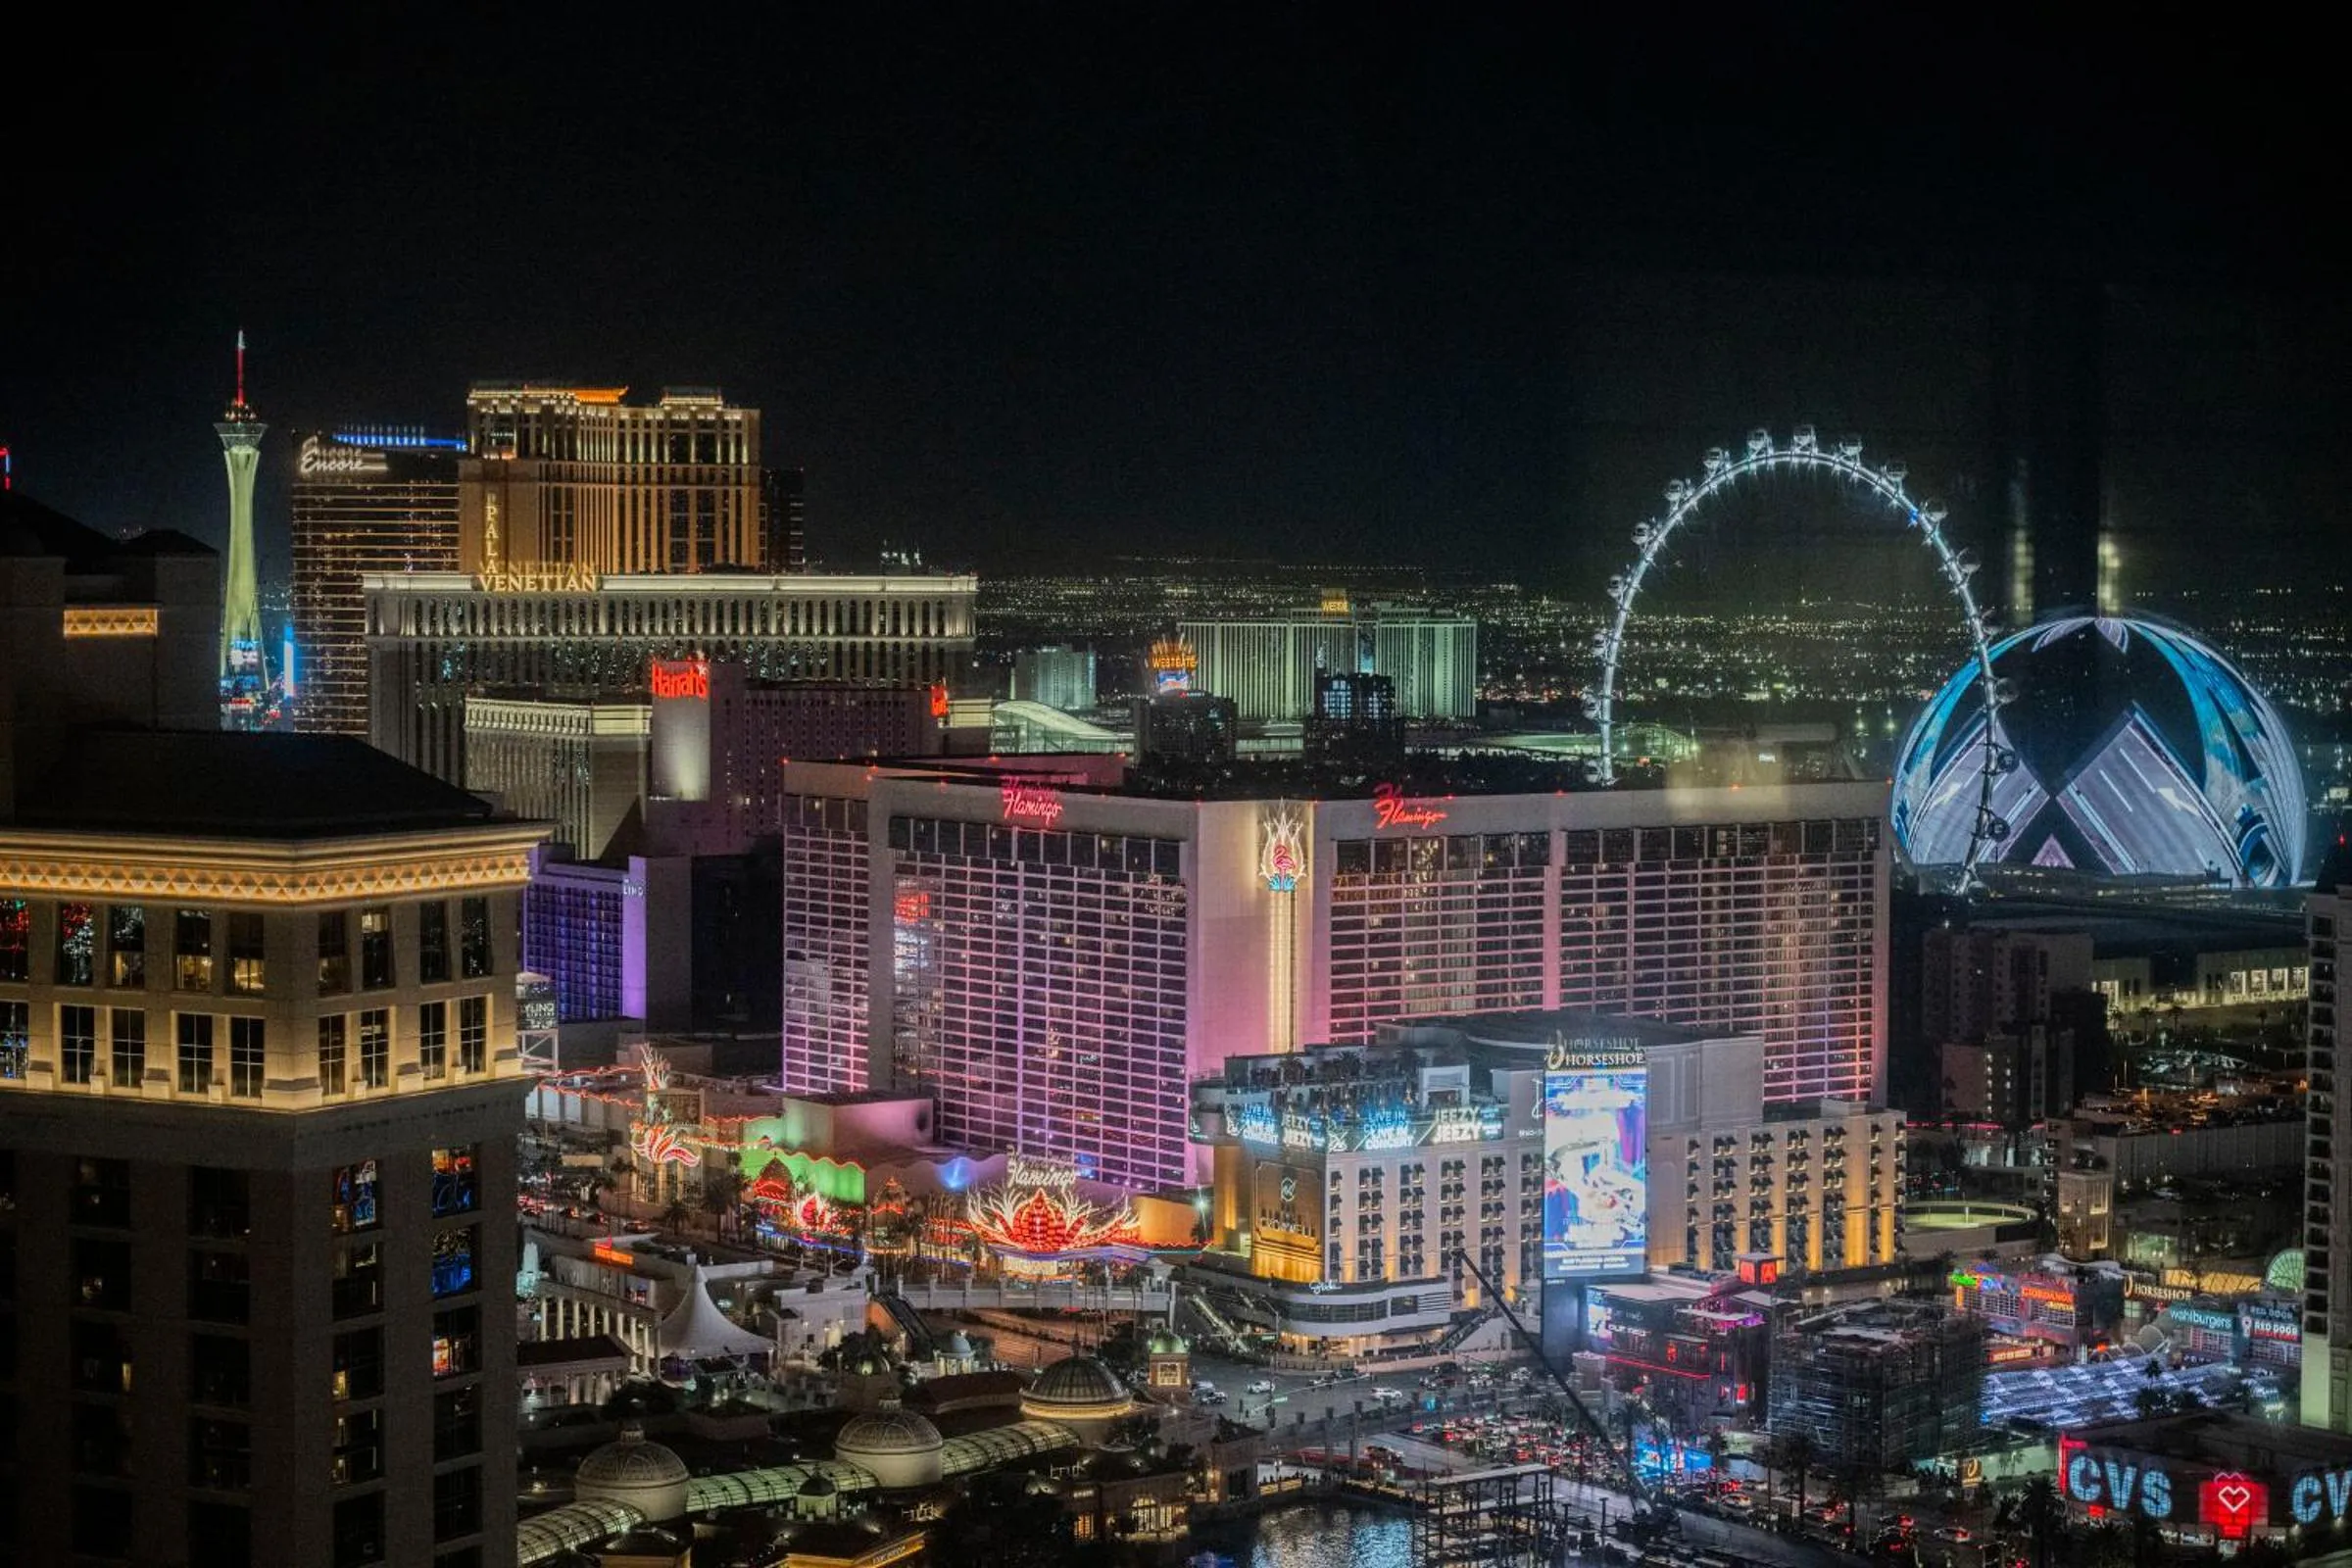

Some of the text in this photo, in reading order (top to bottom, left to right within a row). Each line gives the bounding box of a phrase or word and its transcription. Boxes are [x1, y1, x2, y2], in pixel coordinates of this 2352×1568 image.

[300, 445, 388, 473] Encore
[477, 574, 597, 592] VENETIAN
[1003, 789, 1062, 826] Flamingo
[1374, 799, 1447, 829] Flamingo
[1565, 1053, 1646, 1065] HORSESHOE
[1006, 1160, 1076, 1194] Flamingo
[2134, 1283, 2192, 1301] HORSESHOE
[2170, 1308, 2232, 1330] wahlburgers
[2068, 1454, 2173, 1519] CVS
